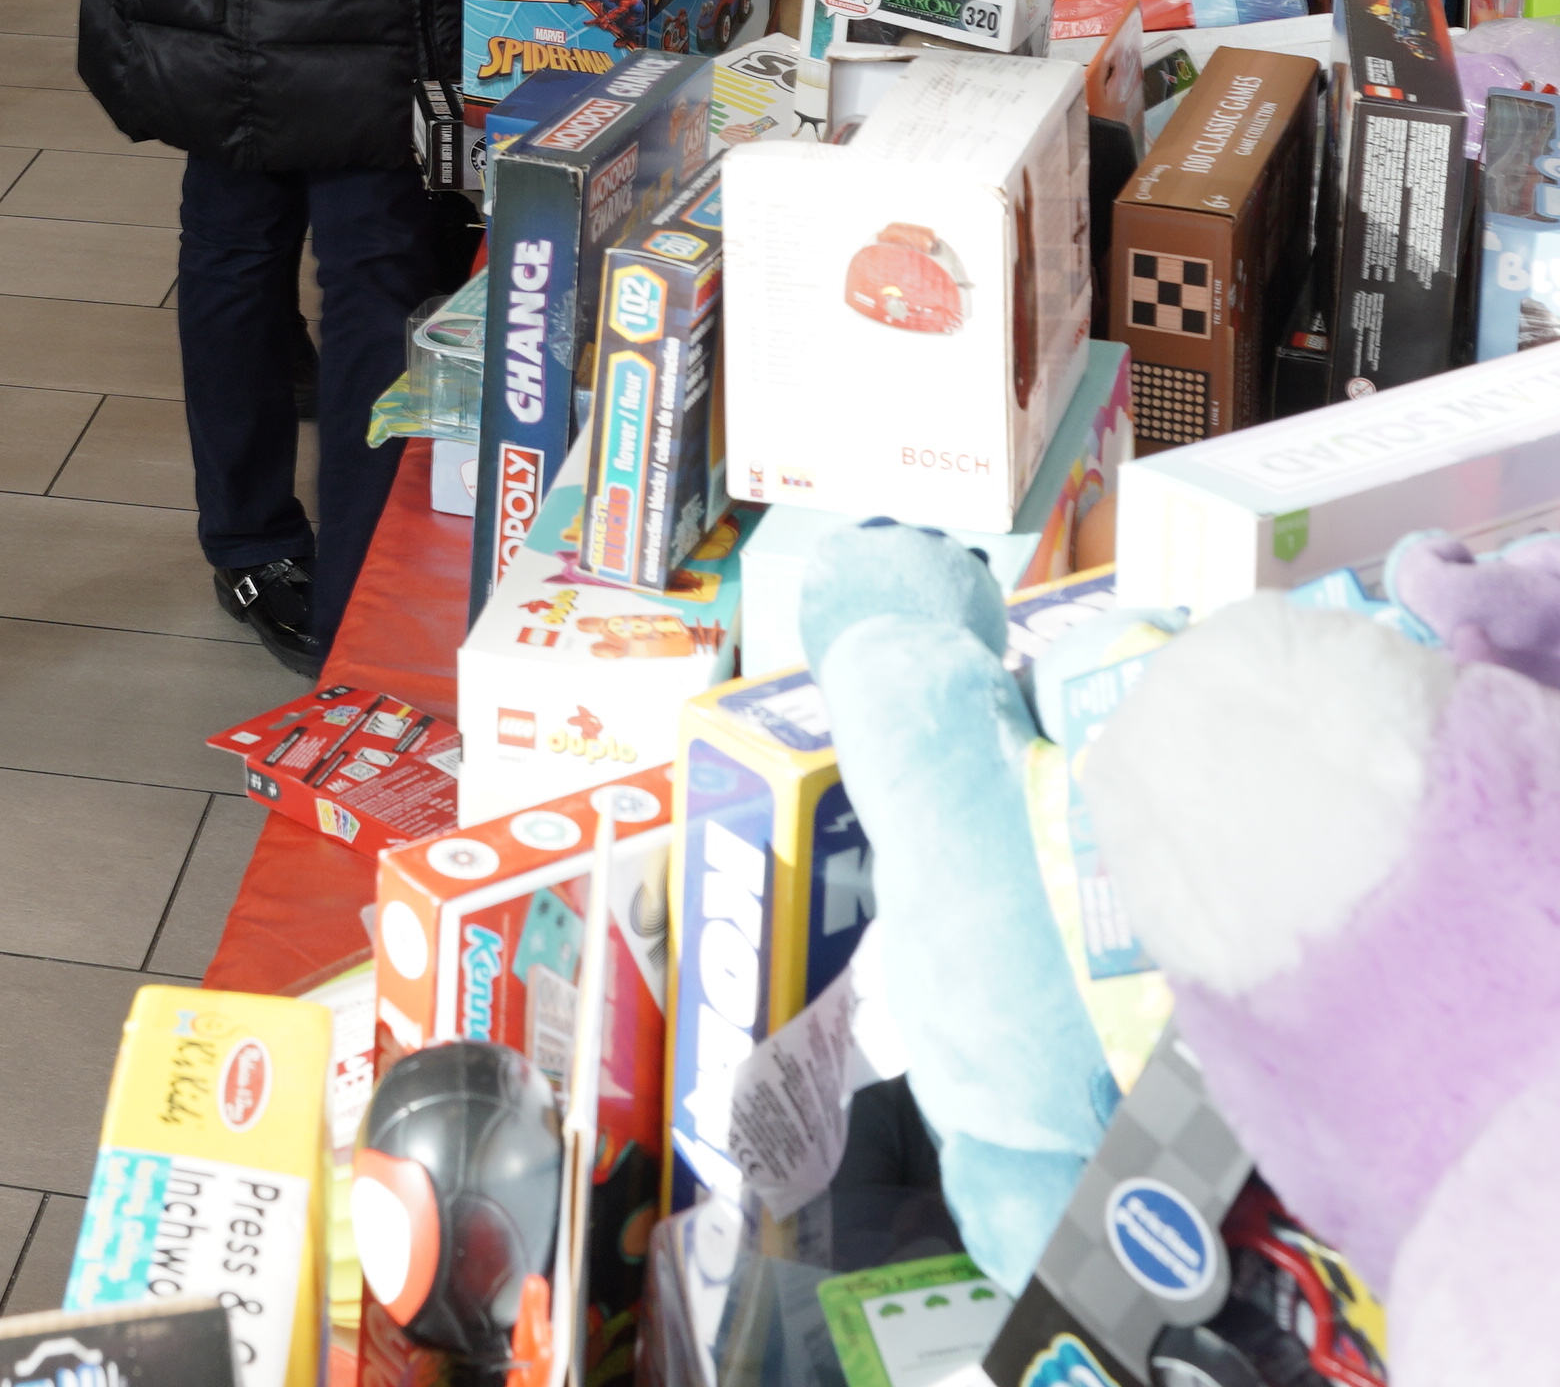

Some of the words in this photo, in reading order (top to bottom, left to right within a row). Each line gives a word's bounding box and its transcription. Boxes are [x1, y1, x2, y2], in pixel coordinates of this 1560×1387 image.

[535, 28, 567, 44] MARVEL
[965, 6, 998, 32] 320
[477, 35, 615, 79] SPIDER-MAN
[441, 125, 453, 143] TITAN
[551, 100, 627, 148] MONOPOLY
[1180, 146, 1214, 175] 100
[1205, 103, 1242, 153] CLASSIC
[1226, 74, 1264, 118] GAMES
[1234, 130, 1255, 156] GAME
[1248, 100, 1279, 138] COLLECTION
[441, 144, 453, 161] HERO
[441, 162, 453, 184] SERIES
[592, 147, 637, 206] MONOPOLY
[1203, 194, 1230, 209] 6+
[619, 277, 649, 327] 102
[1213, 308, 1221, 325] TIC
[505, 238, 553, 424] CHANCE
[620, 371, 643, 411] fleur
[663, 337, 681, 411] construction
[615, 427, 637, 472] flower
[658, 432, 673, 464] cubes
[902, 446, 991, 476] BOSCH
[498, 451, 537, 579] OPOLY
[651, 472, 668, 513] blocks
[591, 499, 609, 566] MAKE-IT
[603, 486, 633, 572] BLOCKS
[645, 514, 664, 584] construction
[499, 717, 537, 738] LEGO
[548, 731, 637, 765] duplo
[464, 927, 502, 1039] Kenn
[149, 1165, 216, 1297] Inchwo
[223, 1177, 280, 1277] Press
[217, 1290, 263, 1315] &
